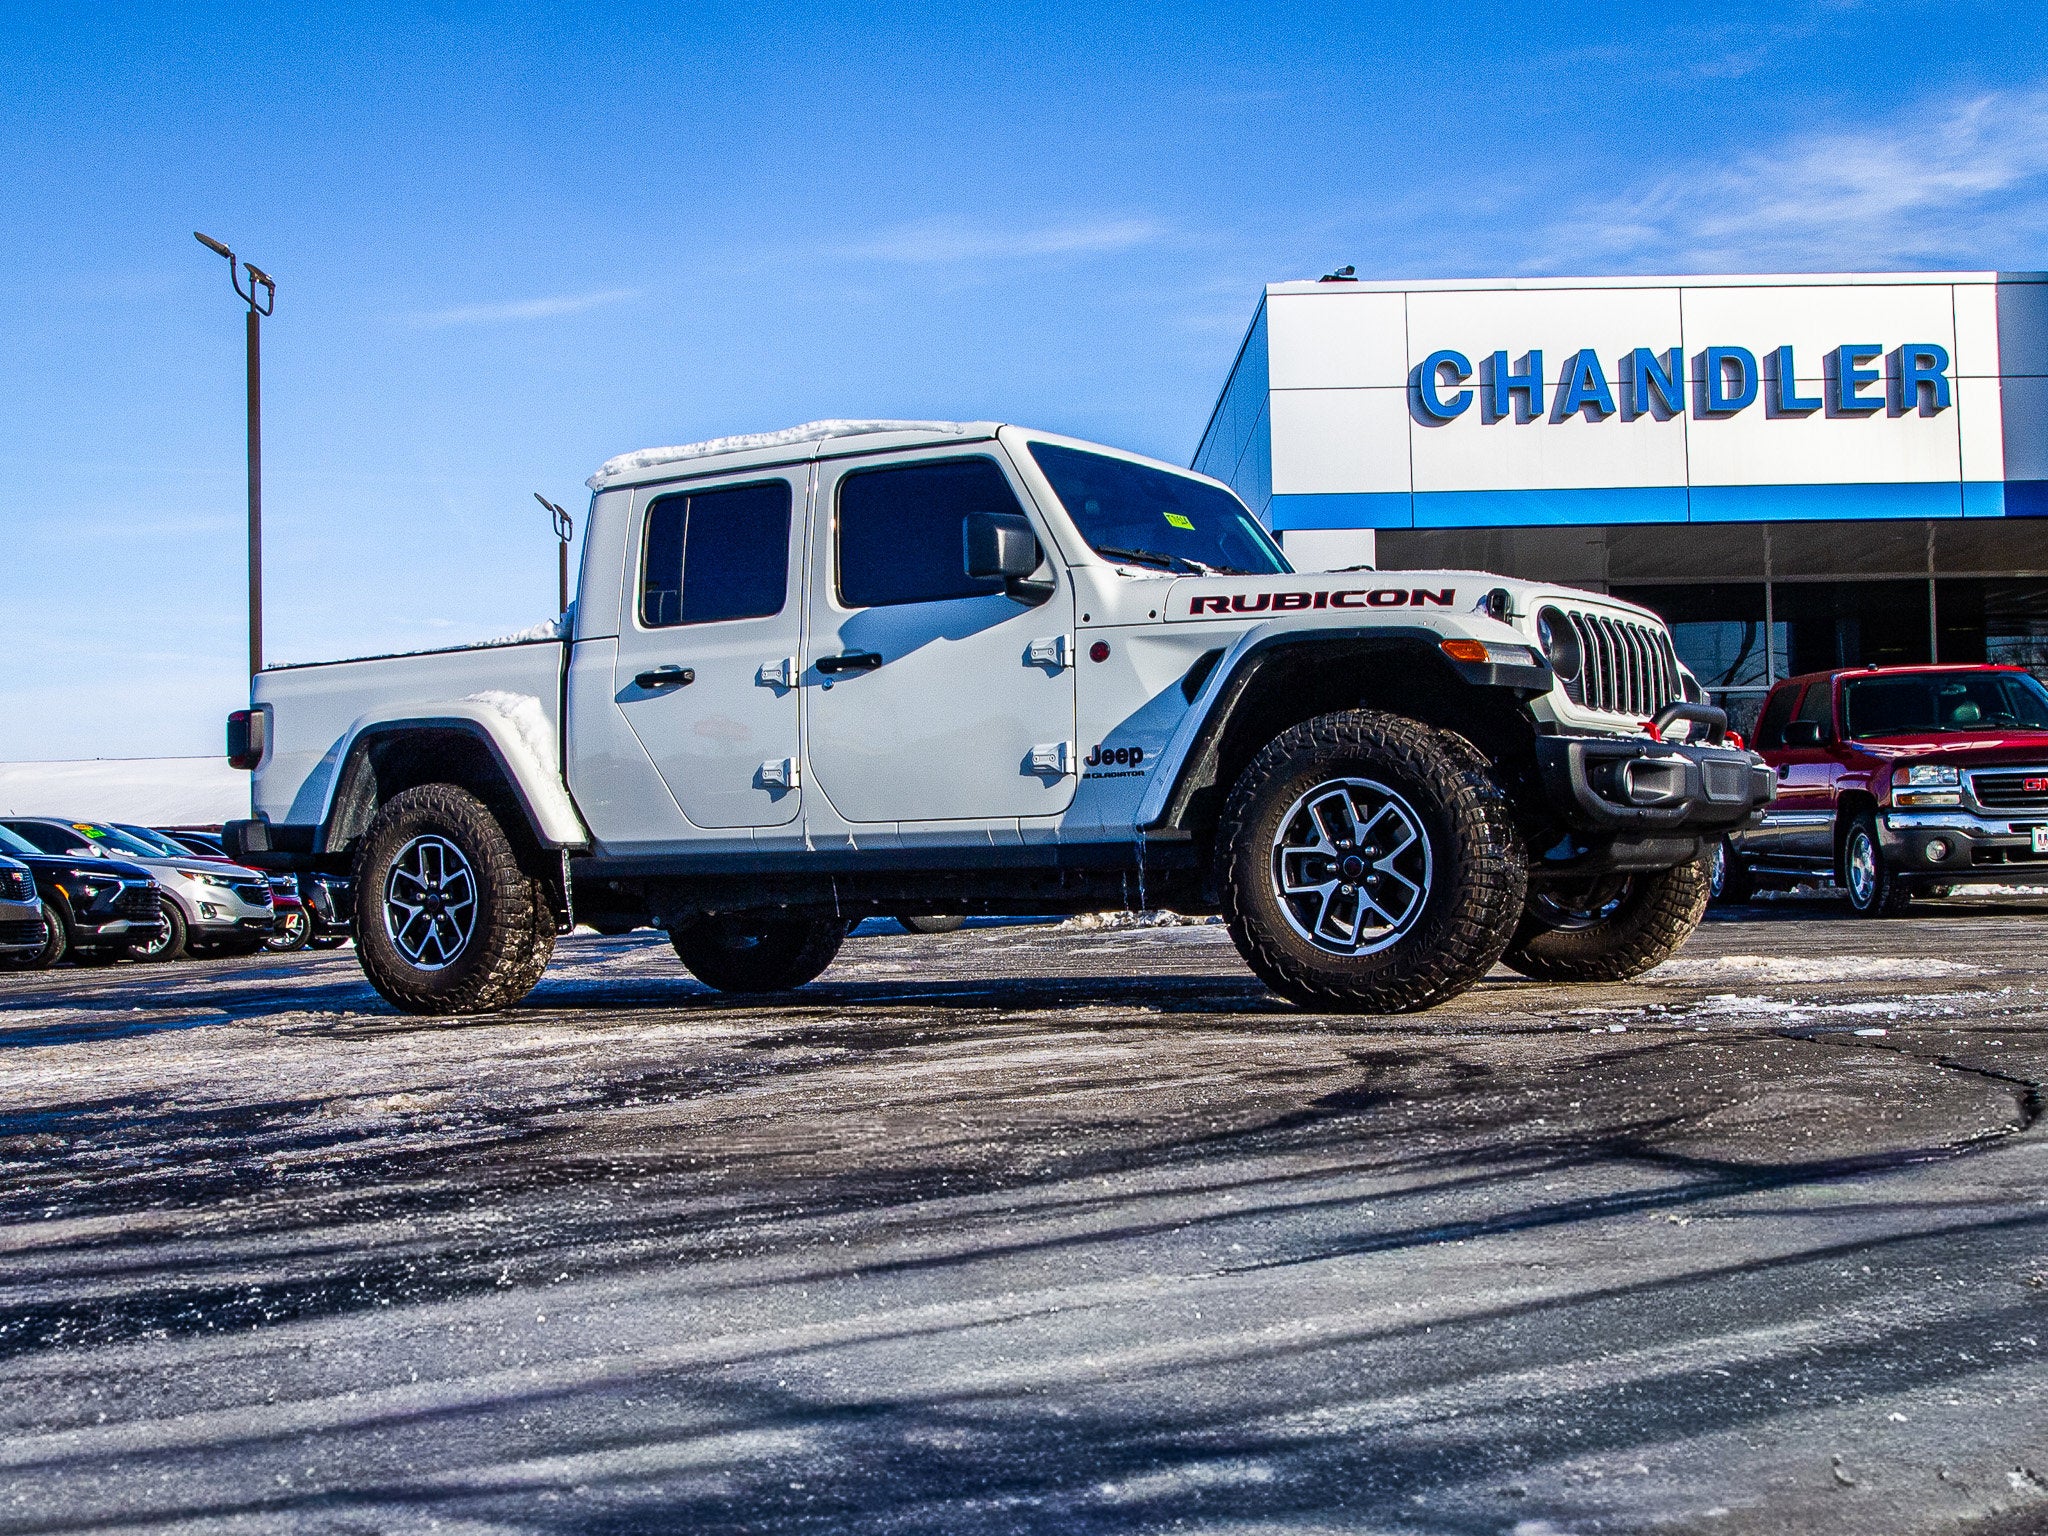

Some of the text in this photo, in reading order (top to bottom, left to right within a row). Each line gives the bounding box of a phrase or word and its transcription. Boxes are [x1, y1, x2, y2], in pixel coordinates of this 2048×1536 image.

[1409, 343, 1952, 425] CHANDLER
[1189, 588, 1456, 615] RUBICON
[1084, 745, 1144, 768] Jeep
[1091, 770, 1145, 779] GLADIATOR
